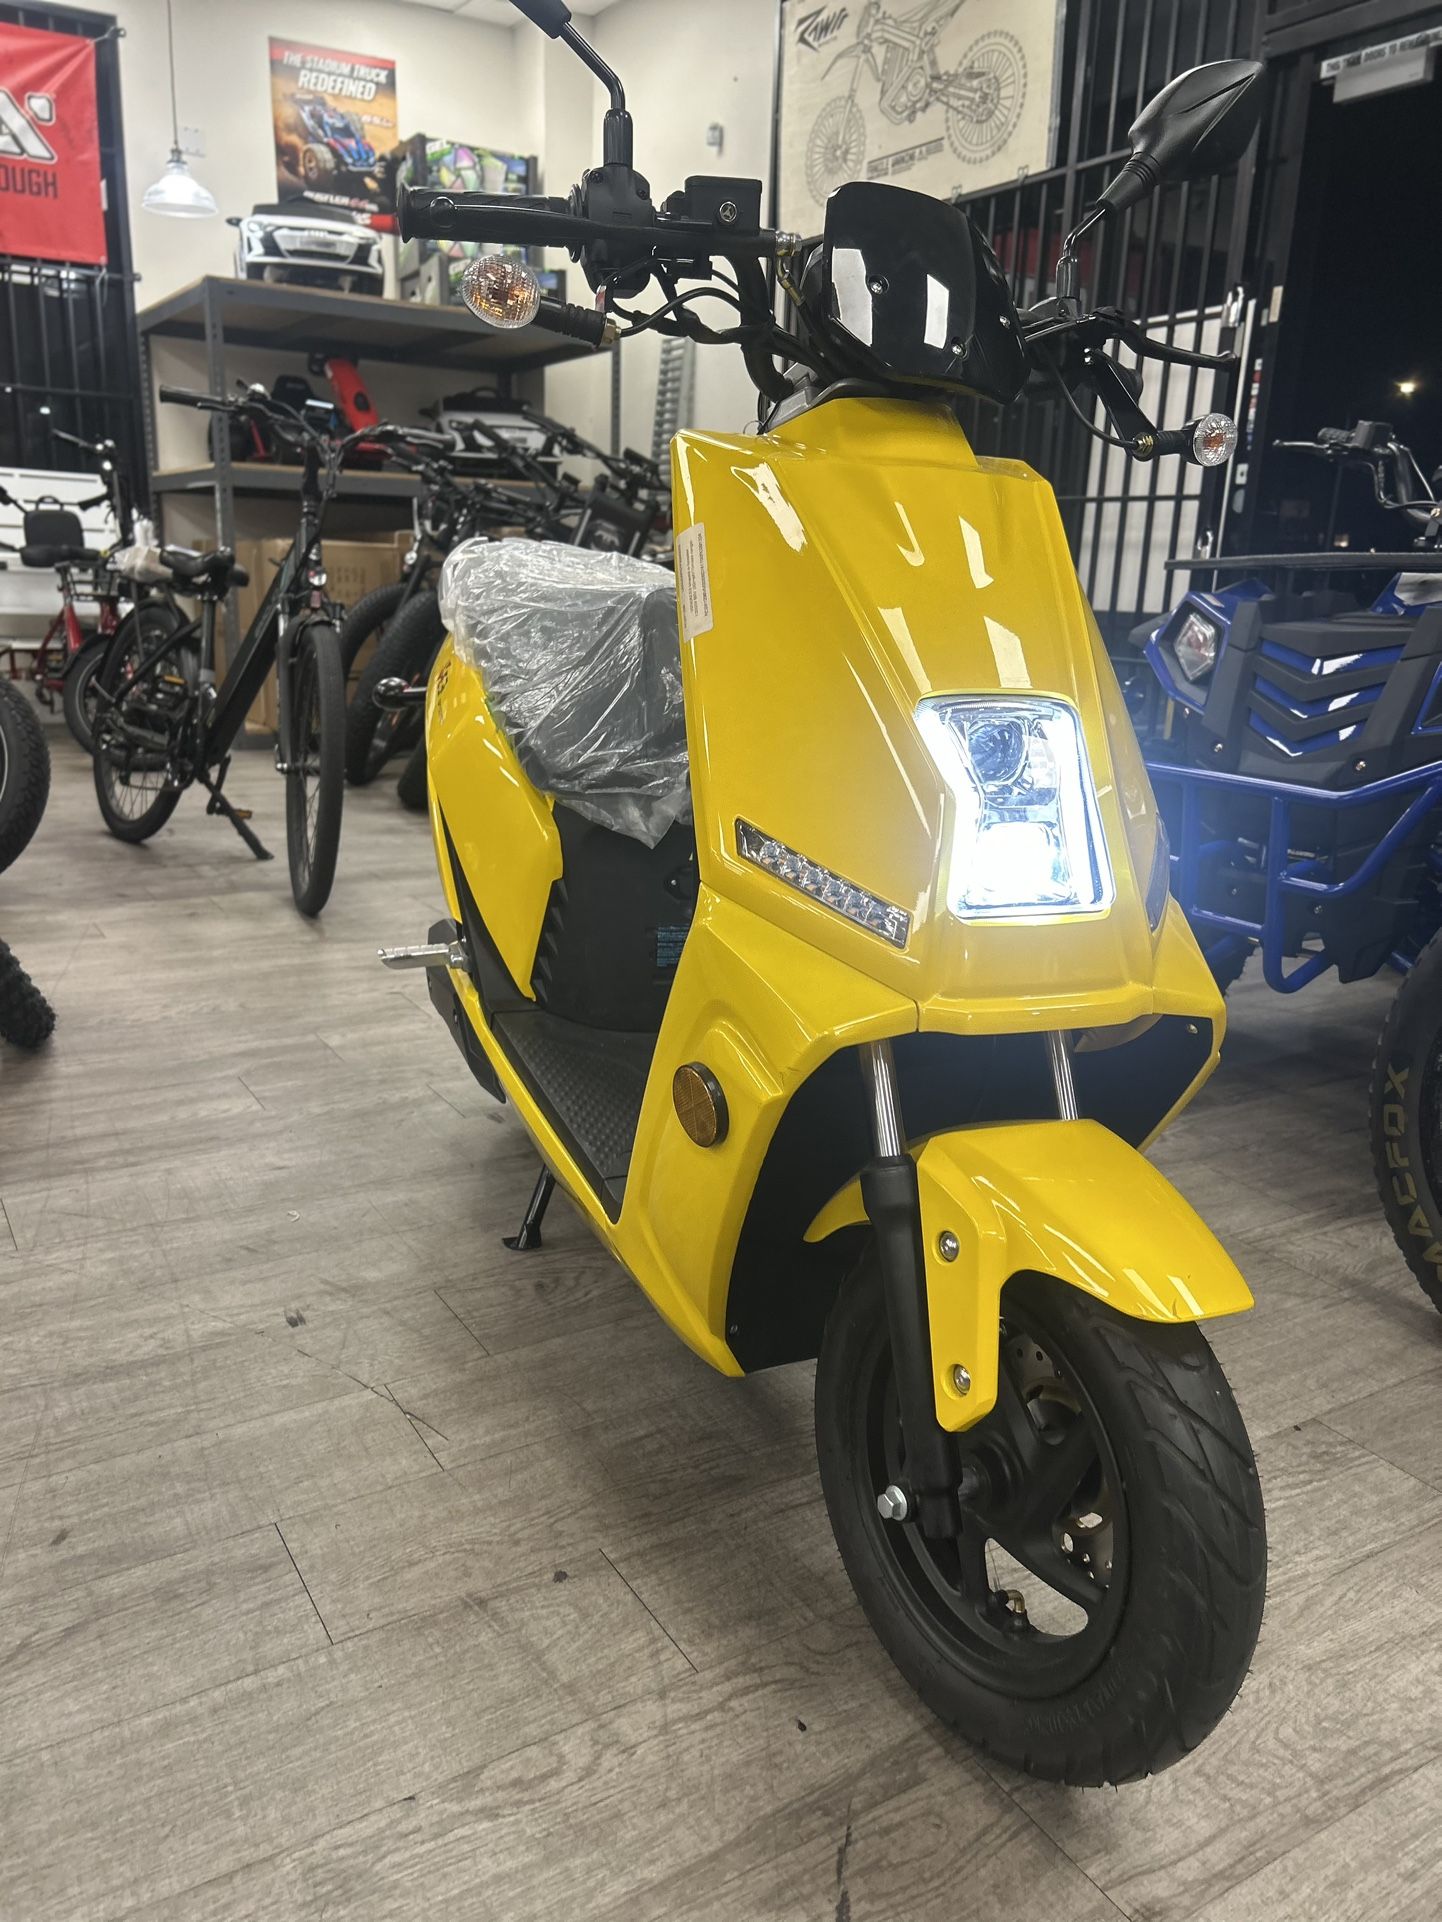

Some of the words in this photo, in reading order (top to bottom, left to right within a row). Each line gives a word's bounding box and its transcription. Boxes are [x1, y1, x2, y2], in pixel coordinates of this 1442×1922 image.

[283, 51, 303, 68] THE
[305, 55, 352, 75] STADIUM
[353, 64, 389, 84] TRUCK
[298, 69, 376, 101] REDEFINED
